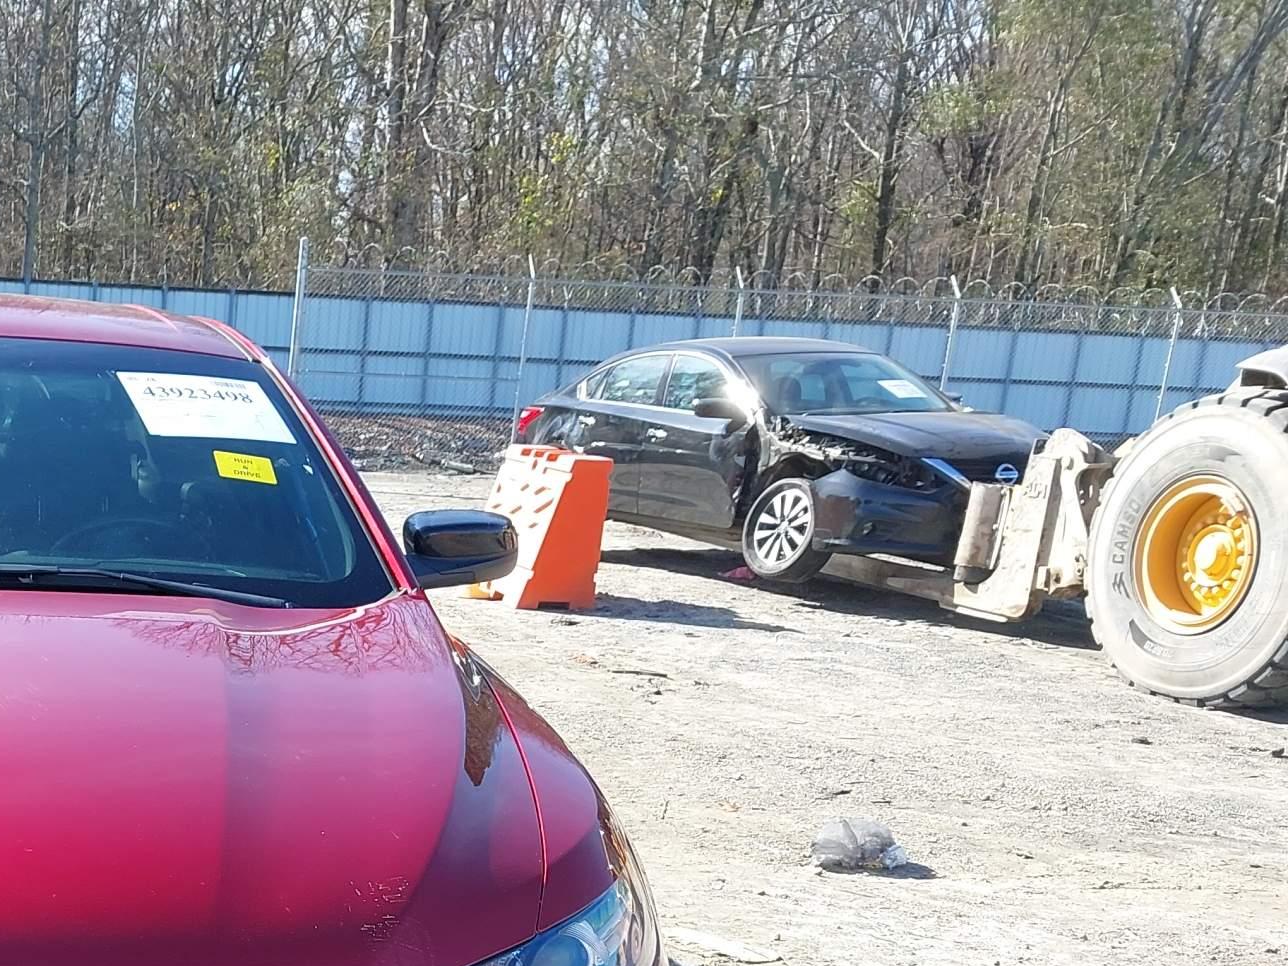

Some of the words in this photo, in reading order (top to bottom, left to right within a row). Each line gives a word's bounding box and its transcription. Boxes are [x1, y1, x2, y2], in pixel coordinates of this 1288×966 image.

[143, 385, 253, 404] 43923498
[233, 457, 253, 465] RUN
[233, 469, 261, 478] DRIVE
[1112, 499, 1141, 564] CAMSO
